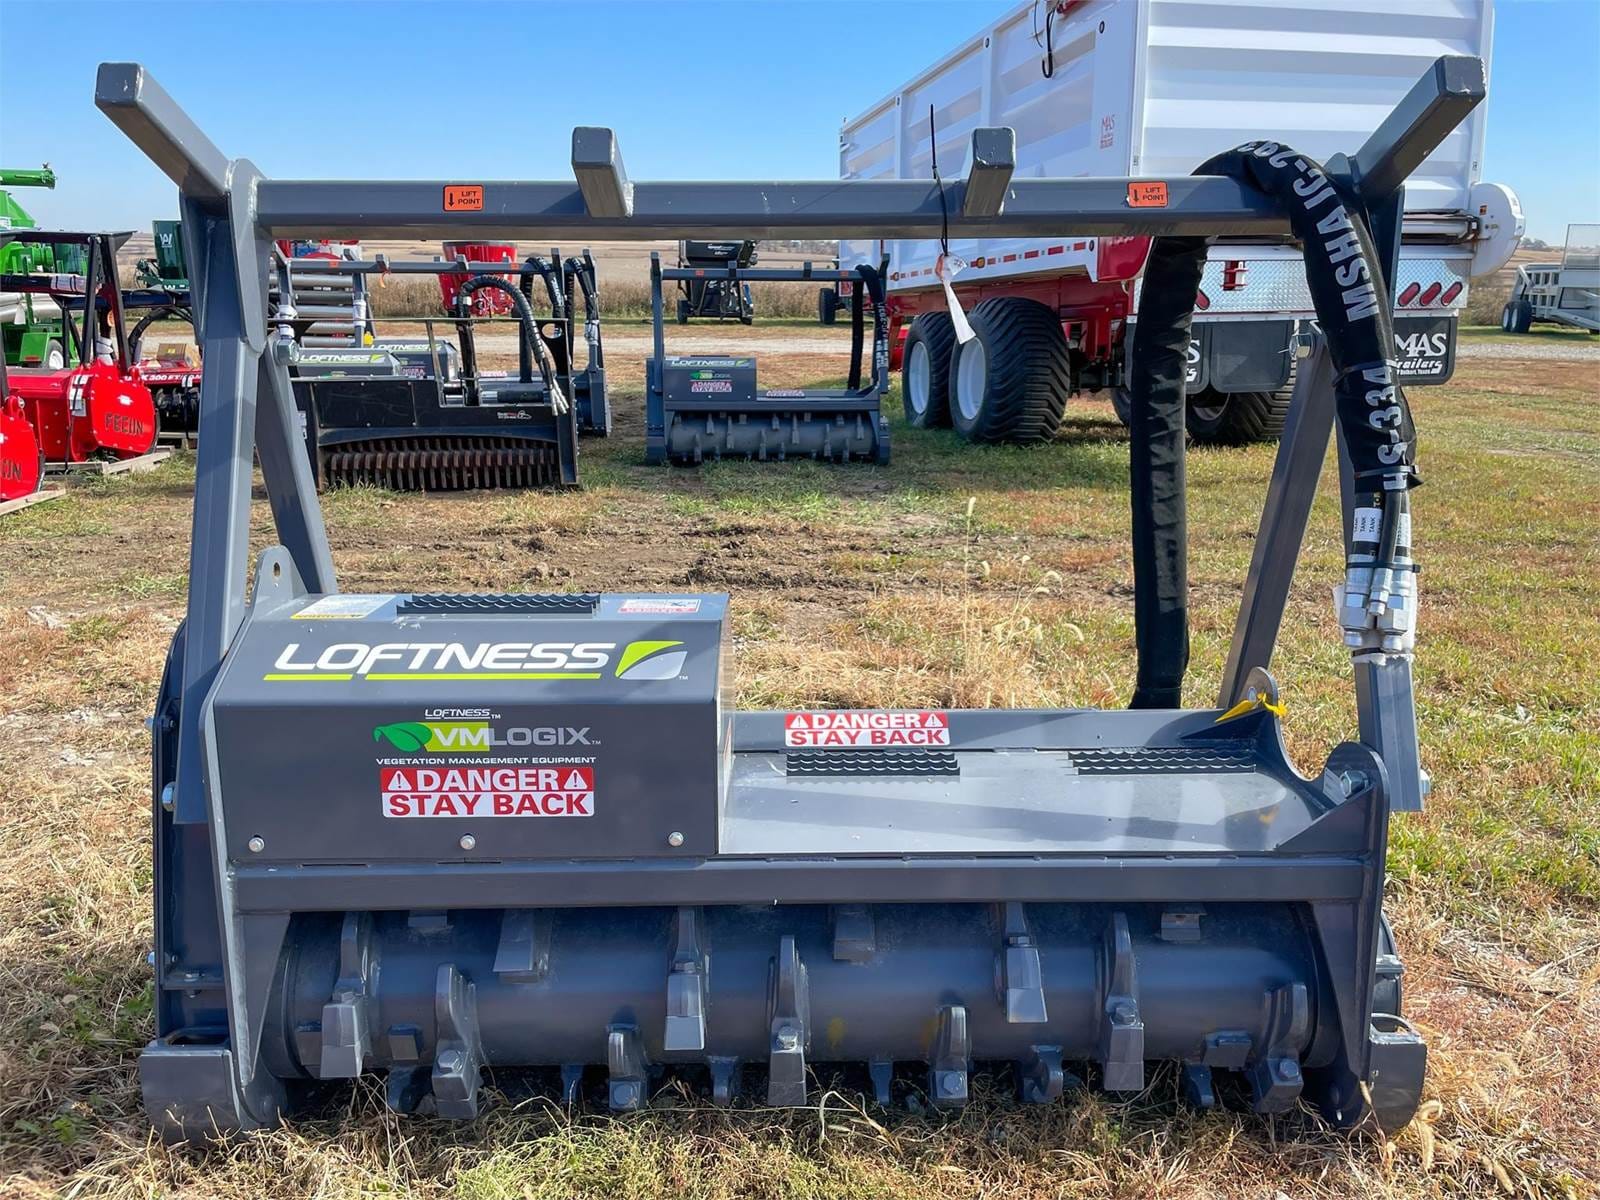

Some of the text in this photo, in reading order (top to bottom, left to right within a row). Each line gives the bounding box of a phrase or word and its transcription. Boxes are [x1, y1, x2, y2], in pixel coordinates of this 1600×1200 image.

[1316, 205, 1380, 322] MSHA
[1394, 333, 1447, 357] MAS
[274, 643, 616, 675] LOFTNESS
[424, 709, 491, 717] LOFTNESS
[812, 713, 921, 728] DANGER
[432, 727, 591, 746] VMLOGIX
[791, 729, 944, 745] STAY BACK
[416, 769, 558, 791] DANGER
[389, 793, 588, 816] STAY BACK
